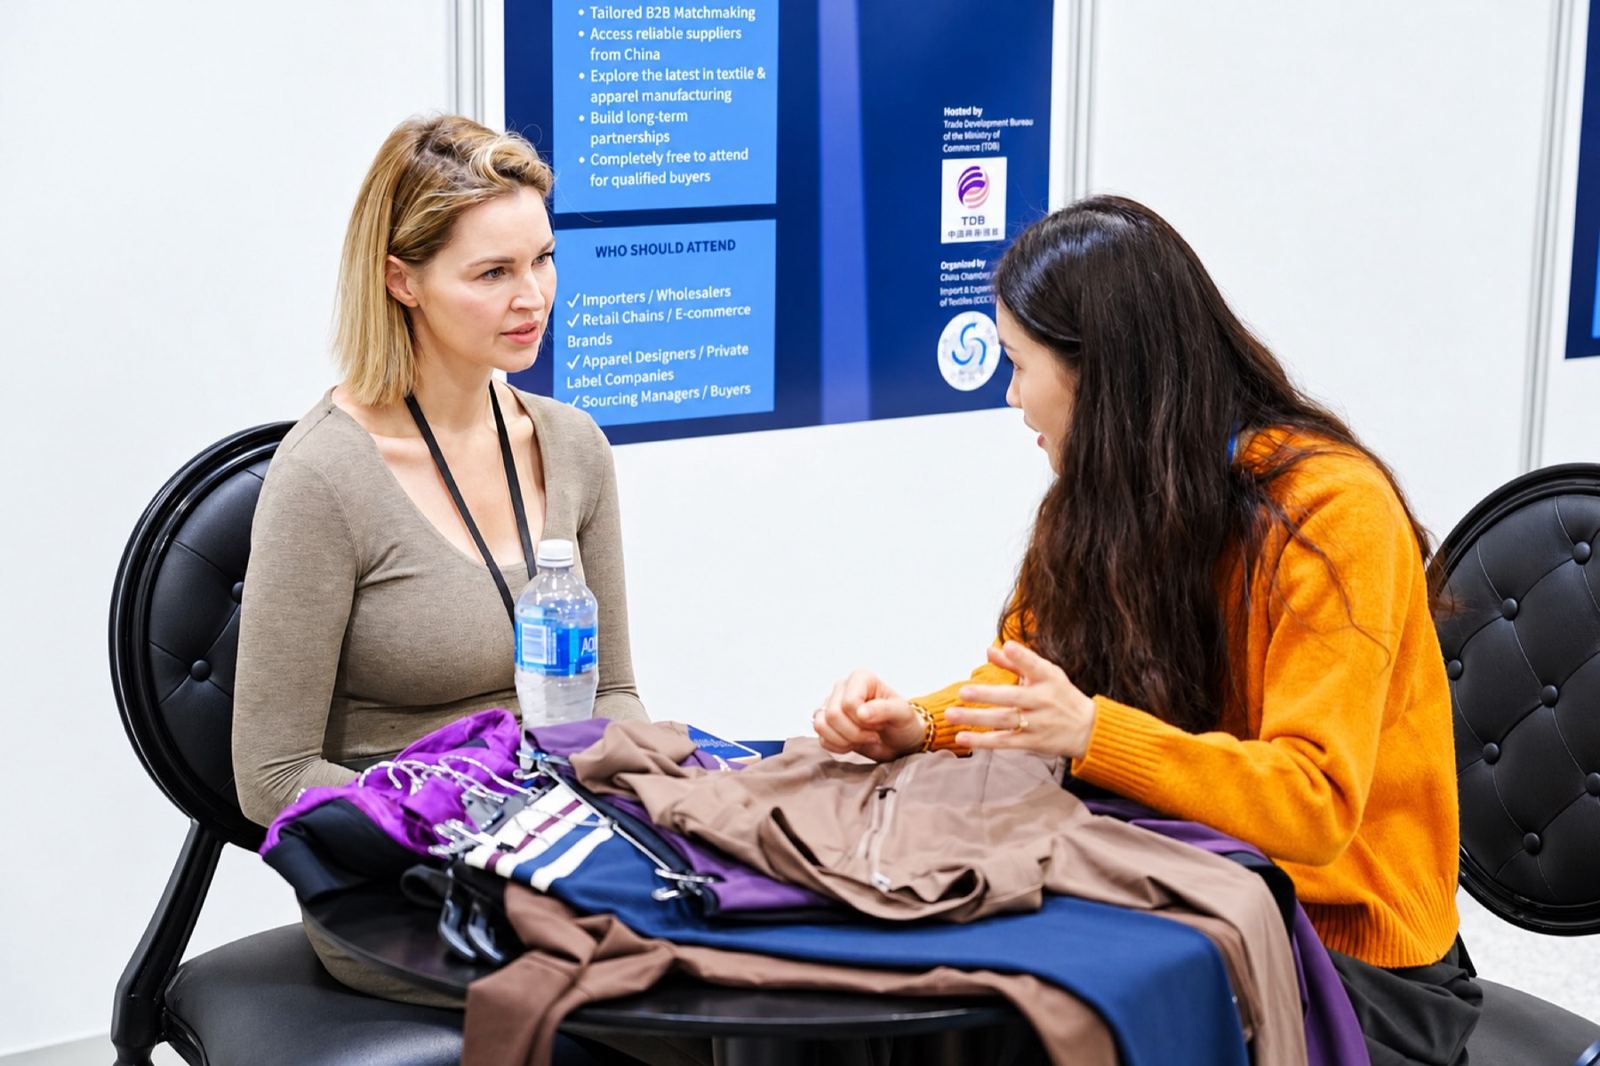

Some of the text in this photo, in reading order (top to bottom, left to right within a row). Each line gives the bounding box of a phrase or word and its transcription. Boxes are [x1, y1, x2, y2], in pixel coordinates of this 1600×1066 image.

[590, 5, 756, 21] Tailored B2B Matchmaking
[590, 27, 742, 42] Access reliable suppliers
[590, 48, 660, 61] from China
[591, 67, 766, 85] Explore the latest in textile &
[591, 88, 732, 105] apparel manufacturing
[591, 110, 688, 126] Build long-term
[944, 106, 983, 117] Hosted by
[944, 118, 1034, 129] Trade Development Bureau
[591, 131, 670, 147] partnerships
[943, 130, 1000, 141] of the Ministry of
[943, 144, 980, 153] Commerce
[591, 148, 748, 168] Completely free to attend
[590, 170, 711, 188] for qualified buyers
[961, 215, 985, 226] TDB
[595, 239, 736, 258] WHO SHOULD ATTEND
[977, 259, 986, 269] by
[582, 286, 731, 308] Importers / Wholesalers
[583, 305, 751, 326] Retail Chains / E-commerce
[568, 332, 612, 348] Brands
[583, 343, 749, 369] Apparel Designers / Private
[567, 369, 674, 389] Label Companies
[582, 383, 751, 408] Sourcing Managers / Buyers
